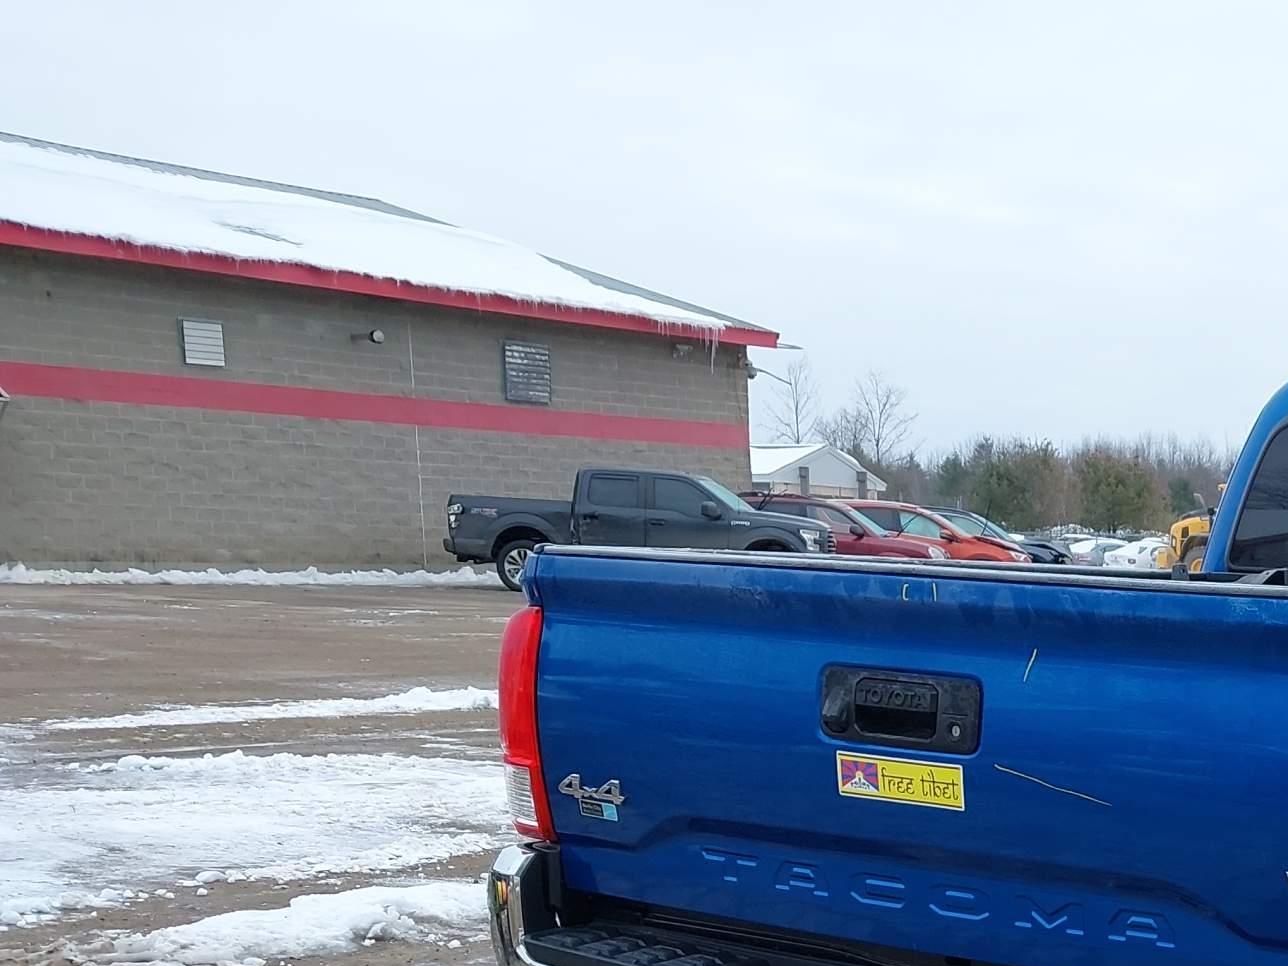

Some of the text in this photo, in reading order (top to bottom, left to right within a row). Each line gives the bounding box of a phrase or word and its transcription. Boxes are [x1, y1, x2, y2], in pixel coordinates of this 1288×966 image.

[861, 687, 928, 710] TOYOTA
[880, 766, 959, 801] free tibet
[700, 848, 1176, 949] TACOMA
